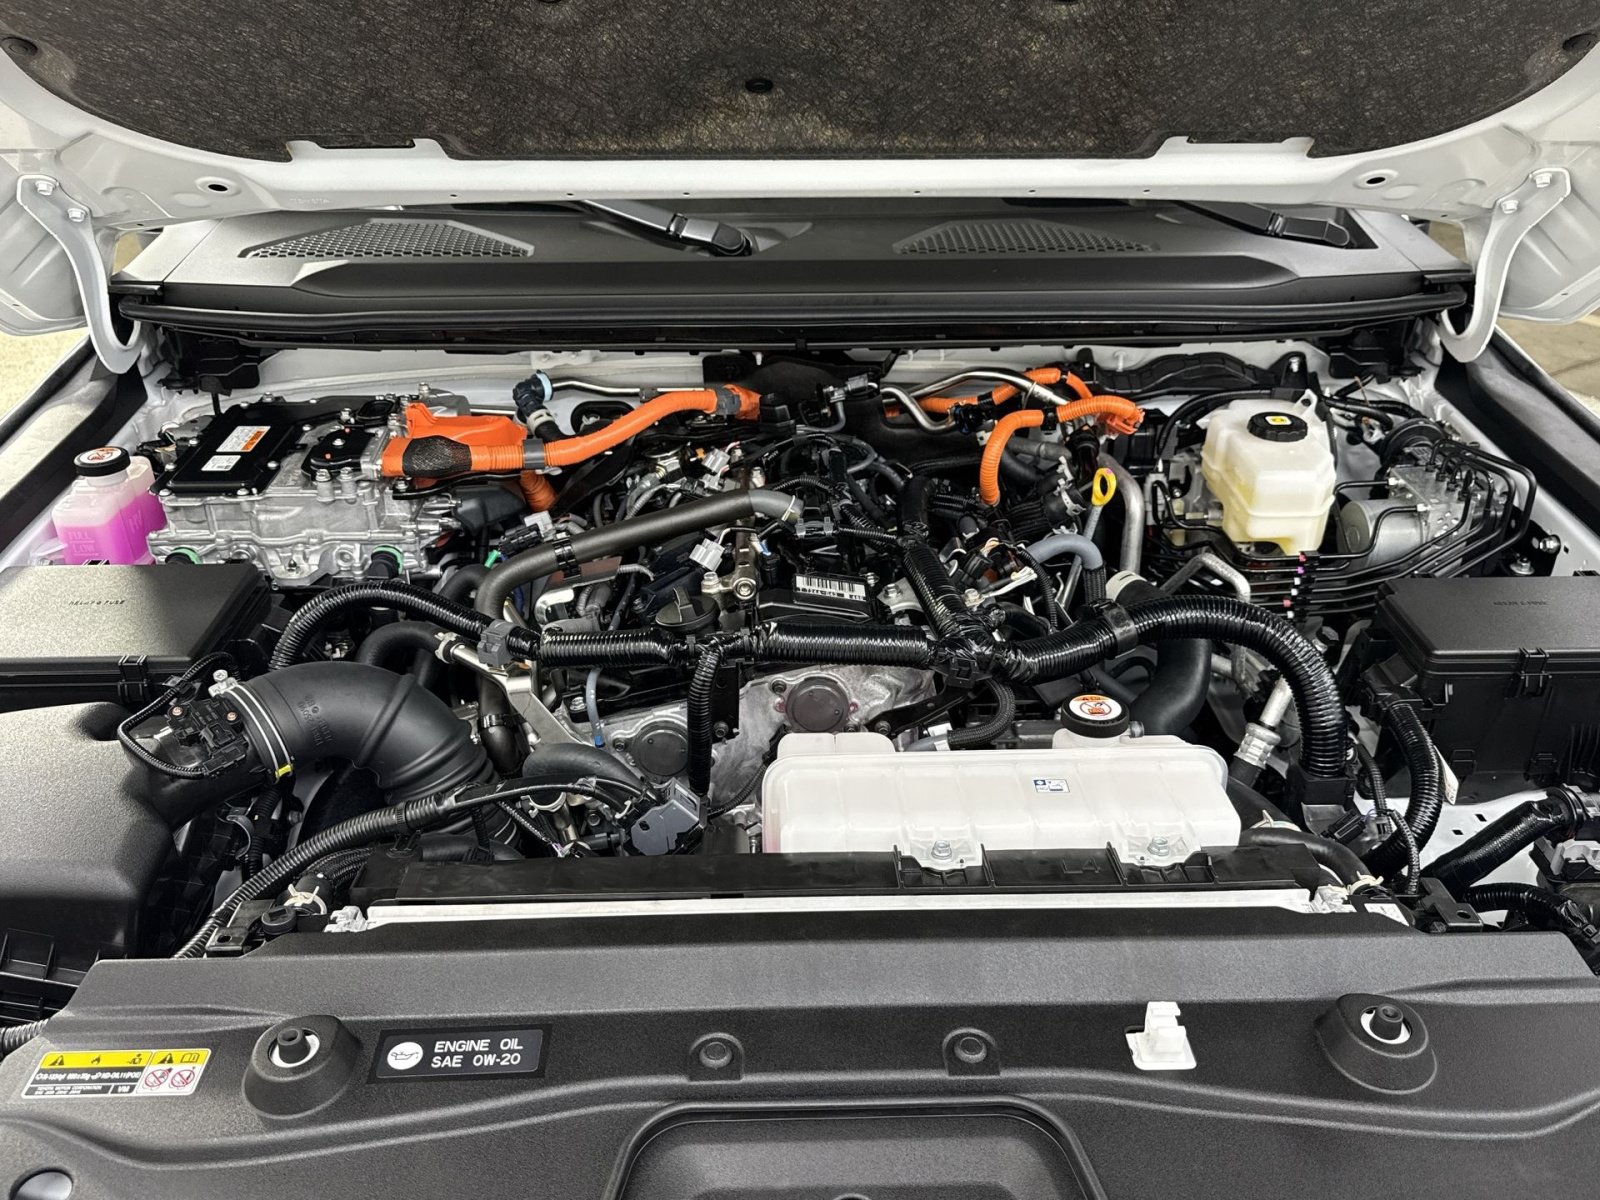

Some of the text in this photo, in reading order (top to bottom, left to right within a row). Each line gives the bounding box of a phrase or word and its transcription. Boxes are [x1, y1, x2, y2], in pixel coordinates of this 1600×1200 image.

[434, 1038, 523, 1052] ENGINE OIL
[431, 1053, 521, 1068] SAE 0W-20
